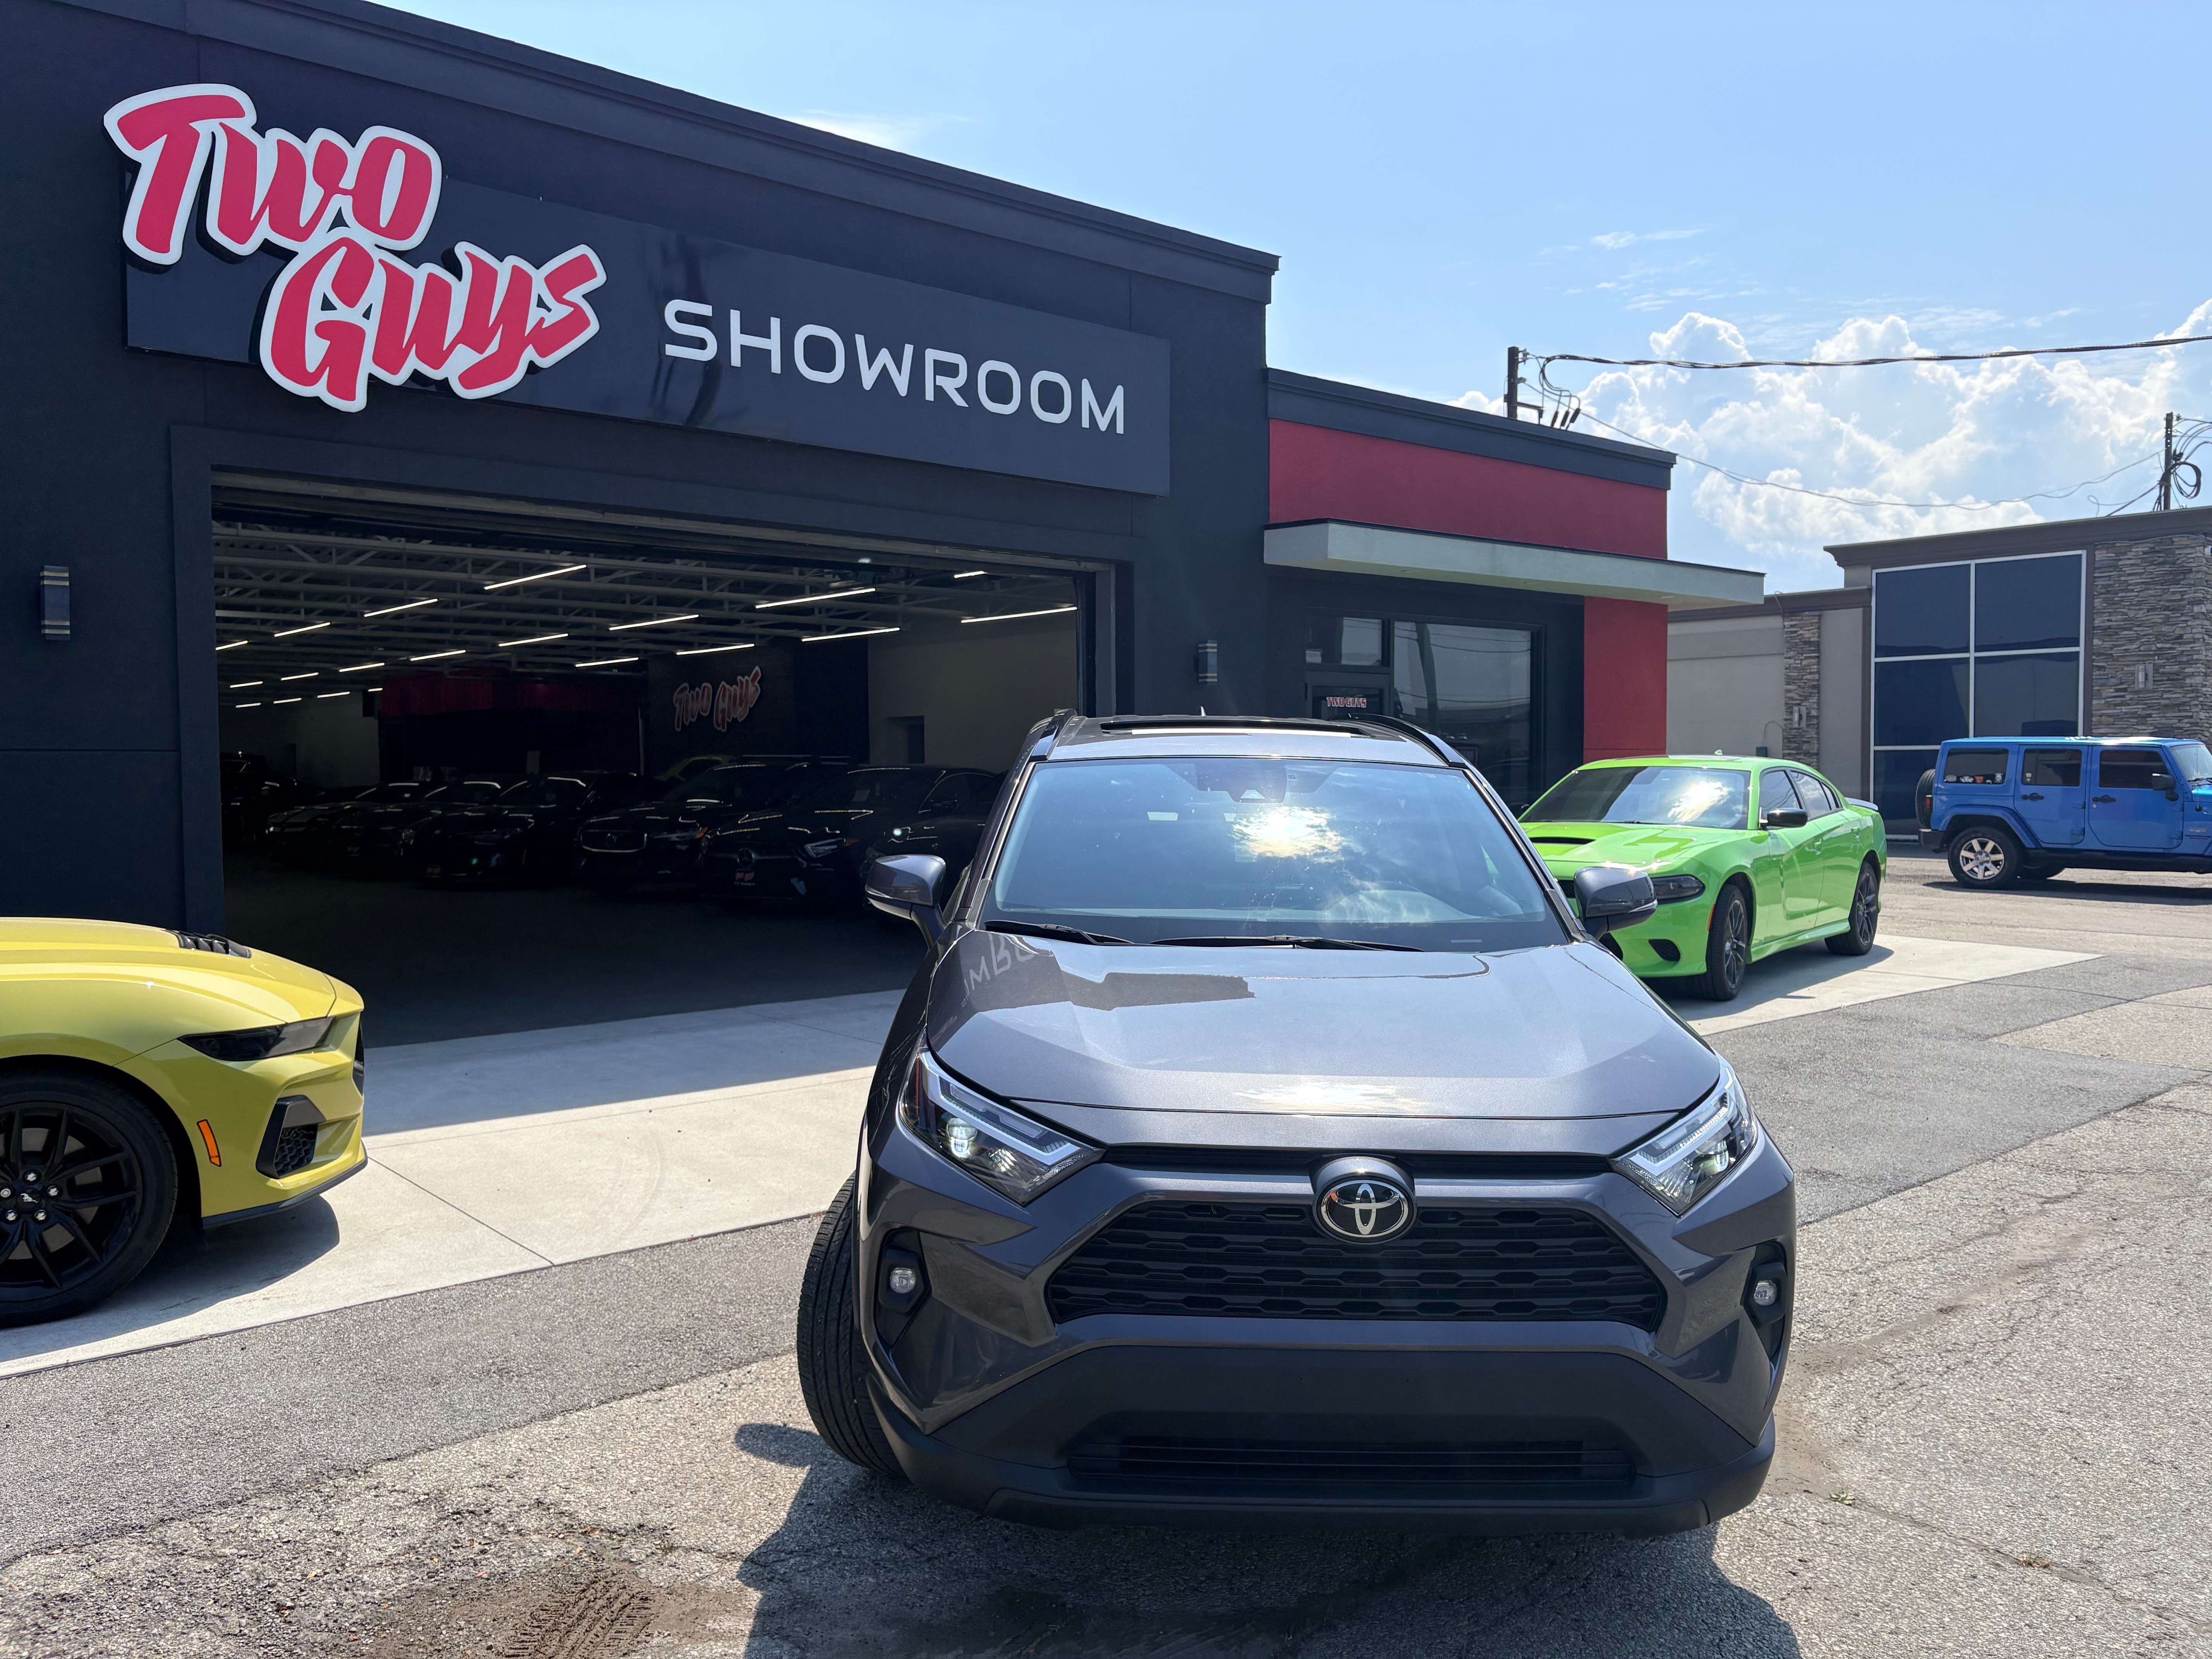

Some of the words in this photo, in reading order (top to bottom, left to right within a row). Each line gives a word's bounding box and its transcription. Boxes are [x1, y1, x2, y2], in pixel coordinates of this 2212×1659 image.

[103, 84, 442, 264] Two
[260, 227, 607, 412] Guys
[664, 299, 1124, 434] SHOWROOM
[1326, 697, 1345, 707] TWO
[1345, 697, 1367, 708] GUYS
